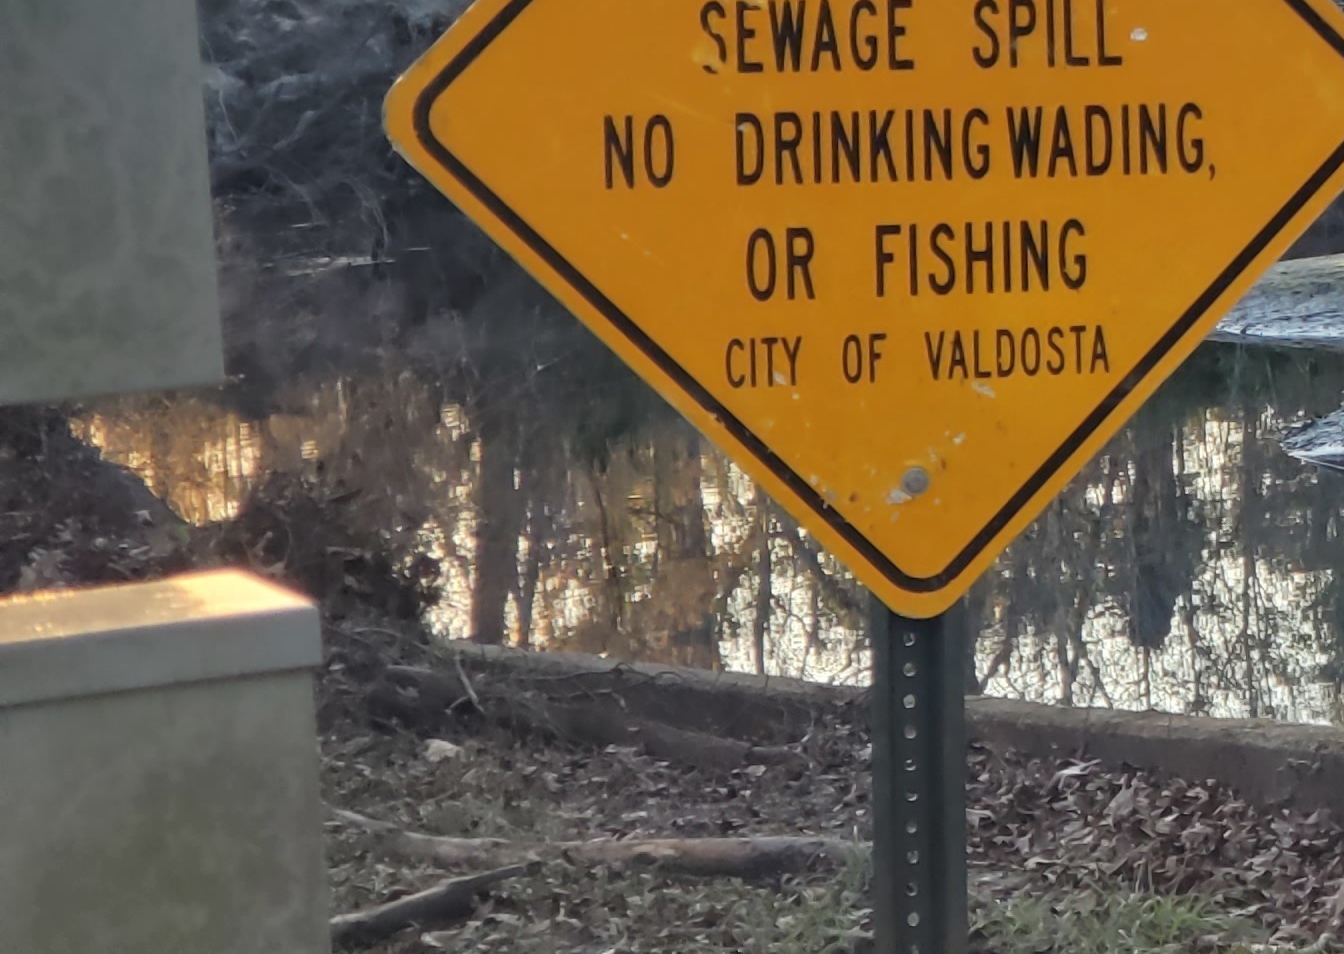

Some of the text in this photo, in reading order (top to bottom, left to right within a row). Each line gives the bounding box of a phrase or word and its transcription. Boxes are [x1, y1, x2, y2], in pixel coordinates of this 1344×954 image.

[603, 102, 1217, 189] NO DRINKING WADING,
[746, 218, 1087, 301] OR FISHING
[725, 325, 1110, 389] CITY OF VALDOSTA
